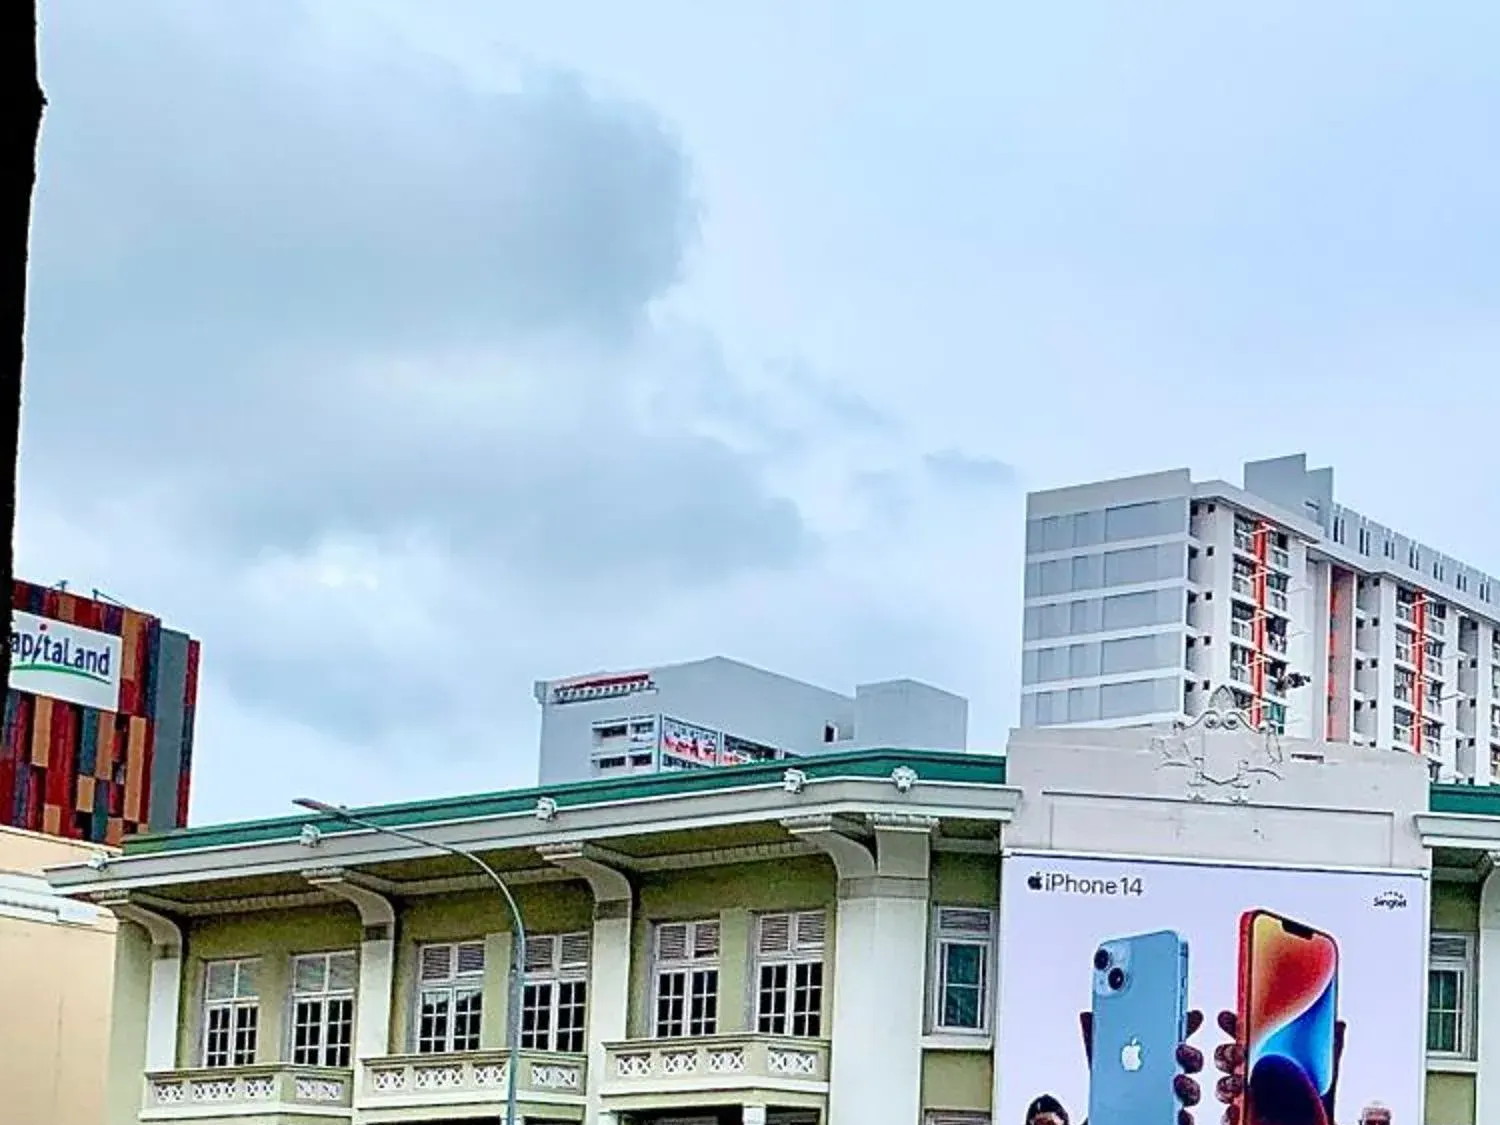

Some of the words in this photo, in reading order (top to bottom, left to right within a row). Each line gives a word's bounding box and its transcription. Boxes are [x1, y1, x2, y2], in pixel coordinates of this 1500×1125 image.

[10, 624, 110, 676] apitaLand
[1045, 873, 1117, 895] iPhone
[1120, 877, 1143, 896] 14
